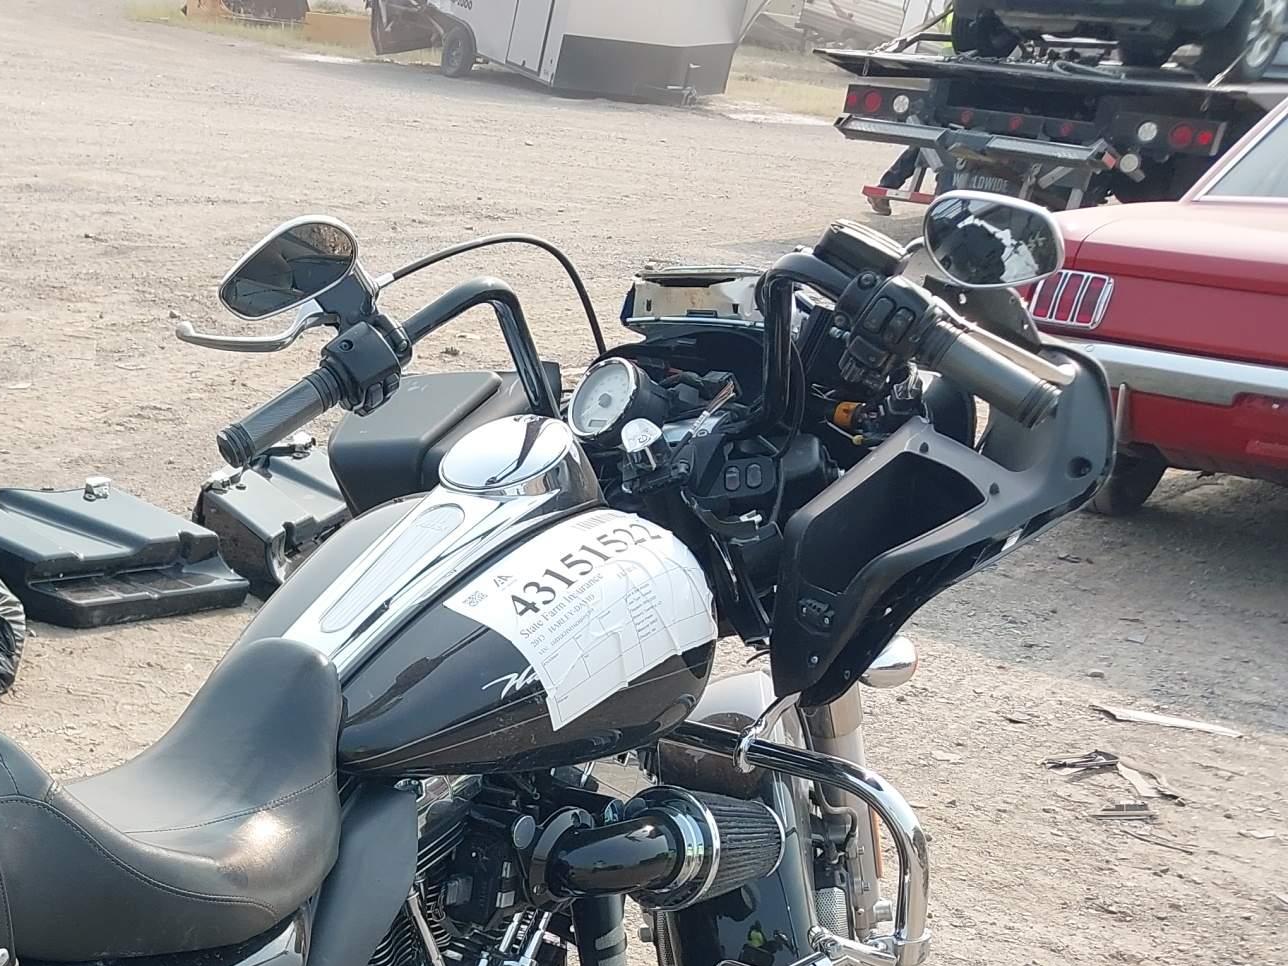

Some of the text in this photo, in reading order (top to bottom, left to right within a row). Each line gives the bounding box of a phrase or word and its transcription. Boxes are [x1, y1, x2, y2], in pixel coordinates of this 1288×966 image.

[952, 172, 1009, 193] WLDWIDE
[510, 523, 662, 617] 43151522
[519, 620, 544, 639] State
[542, 603, 566, 622] Farm
[563, 573, 604, 605] Insurance
